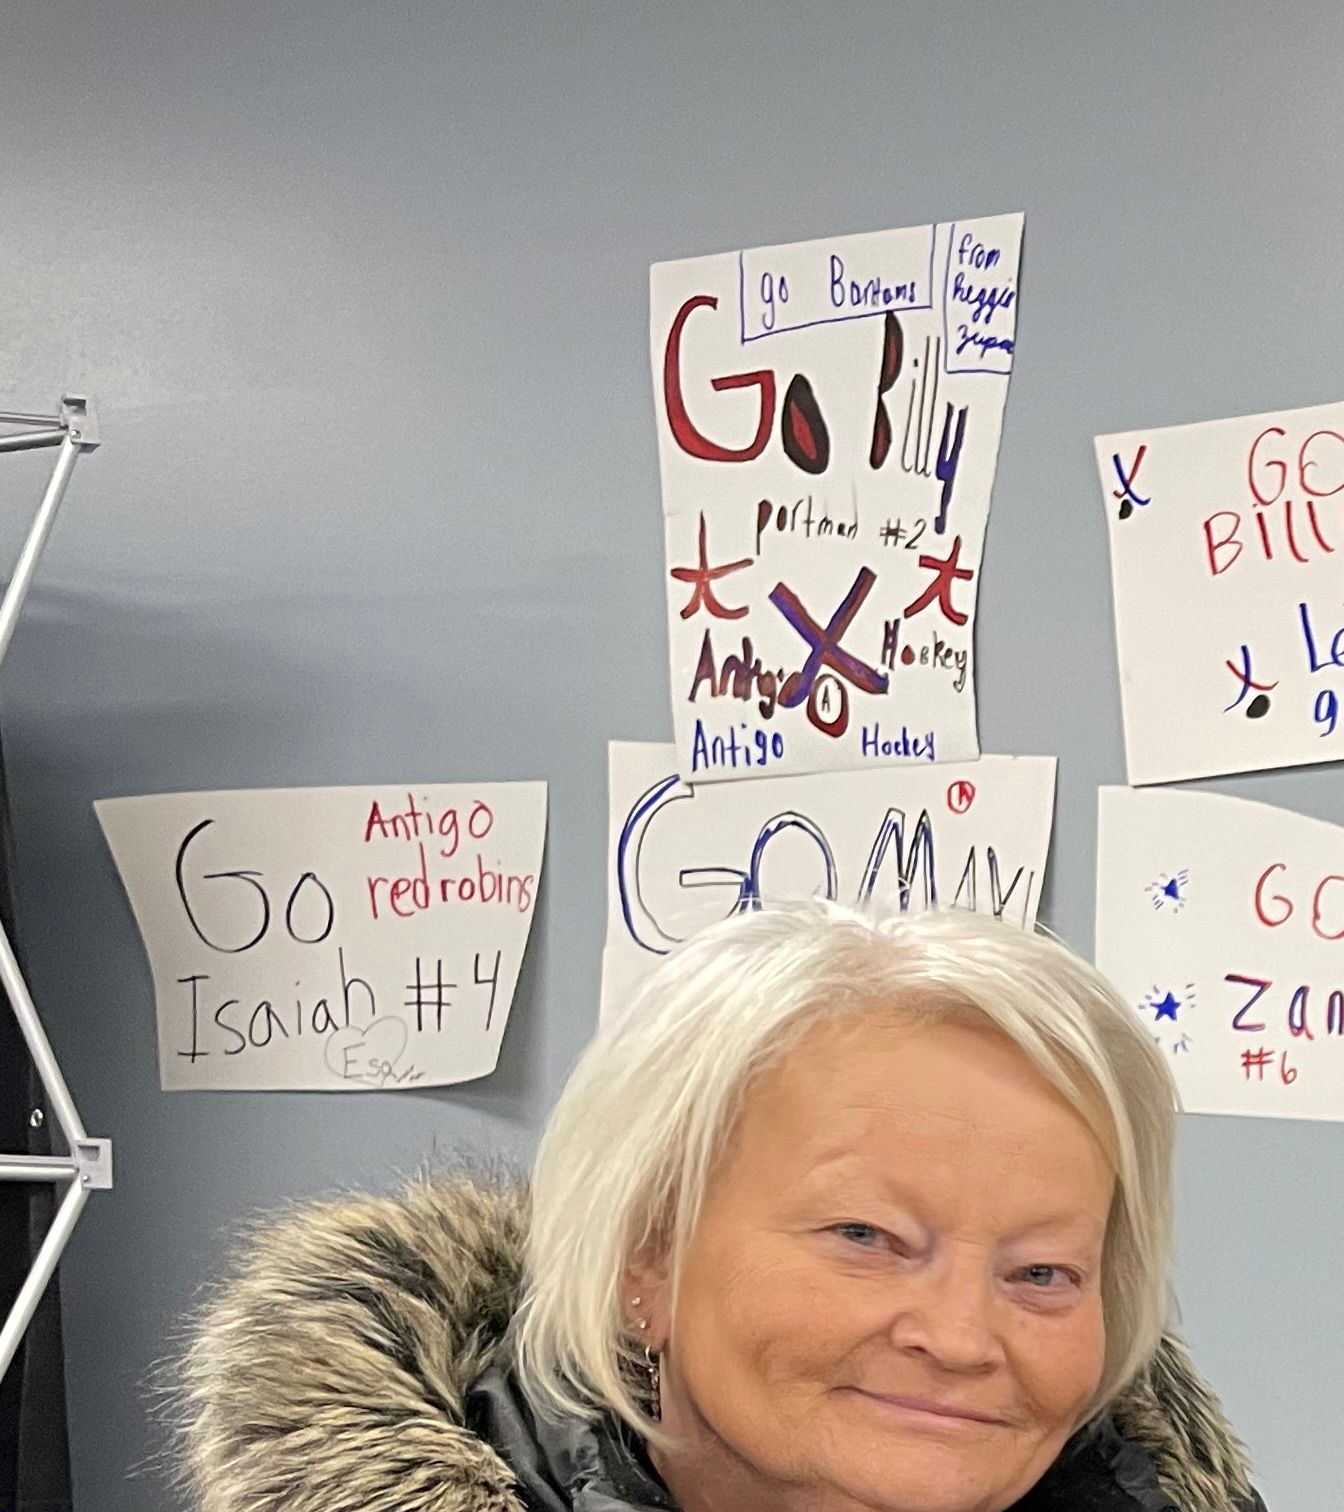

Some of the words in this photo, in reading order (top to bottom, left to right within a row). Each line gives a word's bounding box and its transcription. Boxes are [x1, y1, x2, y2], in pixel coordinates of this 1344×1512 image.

[879, 517, 928, 549] #2
[691, 719, 784, 773] Antigo
[176, 947, 377, 1064] Isaiah
[1240, 1046, 1298, 1086] #6
